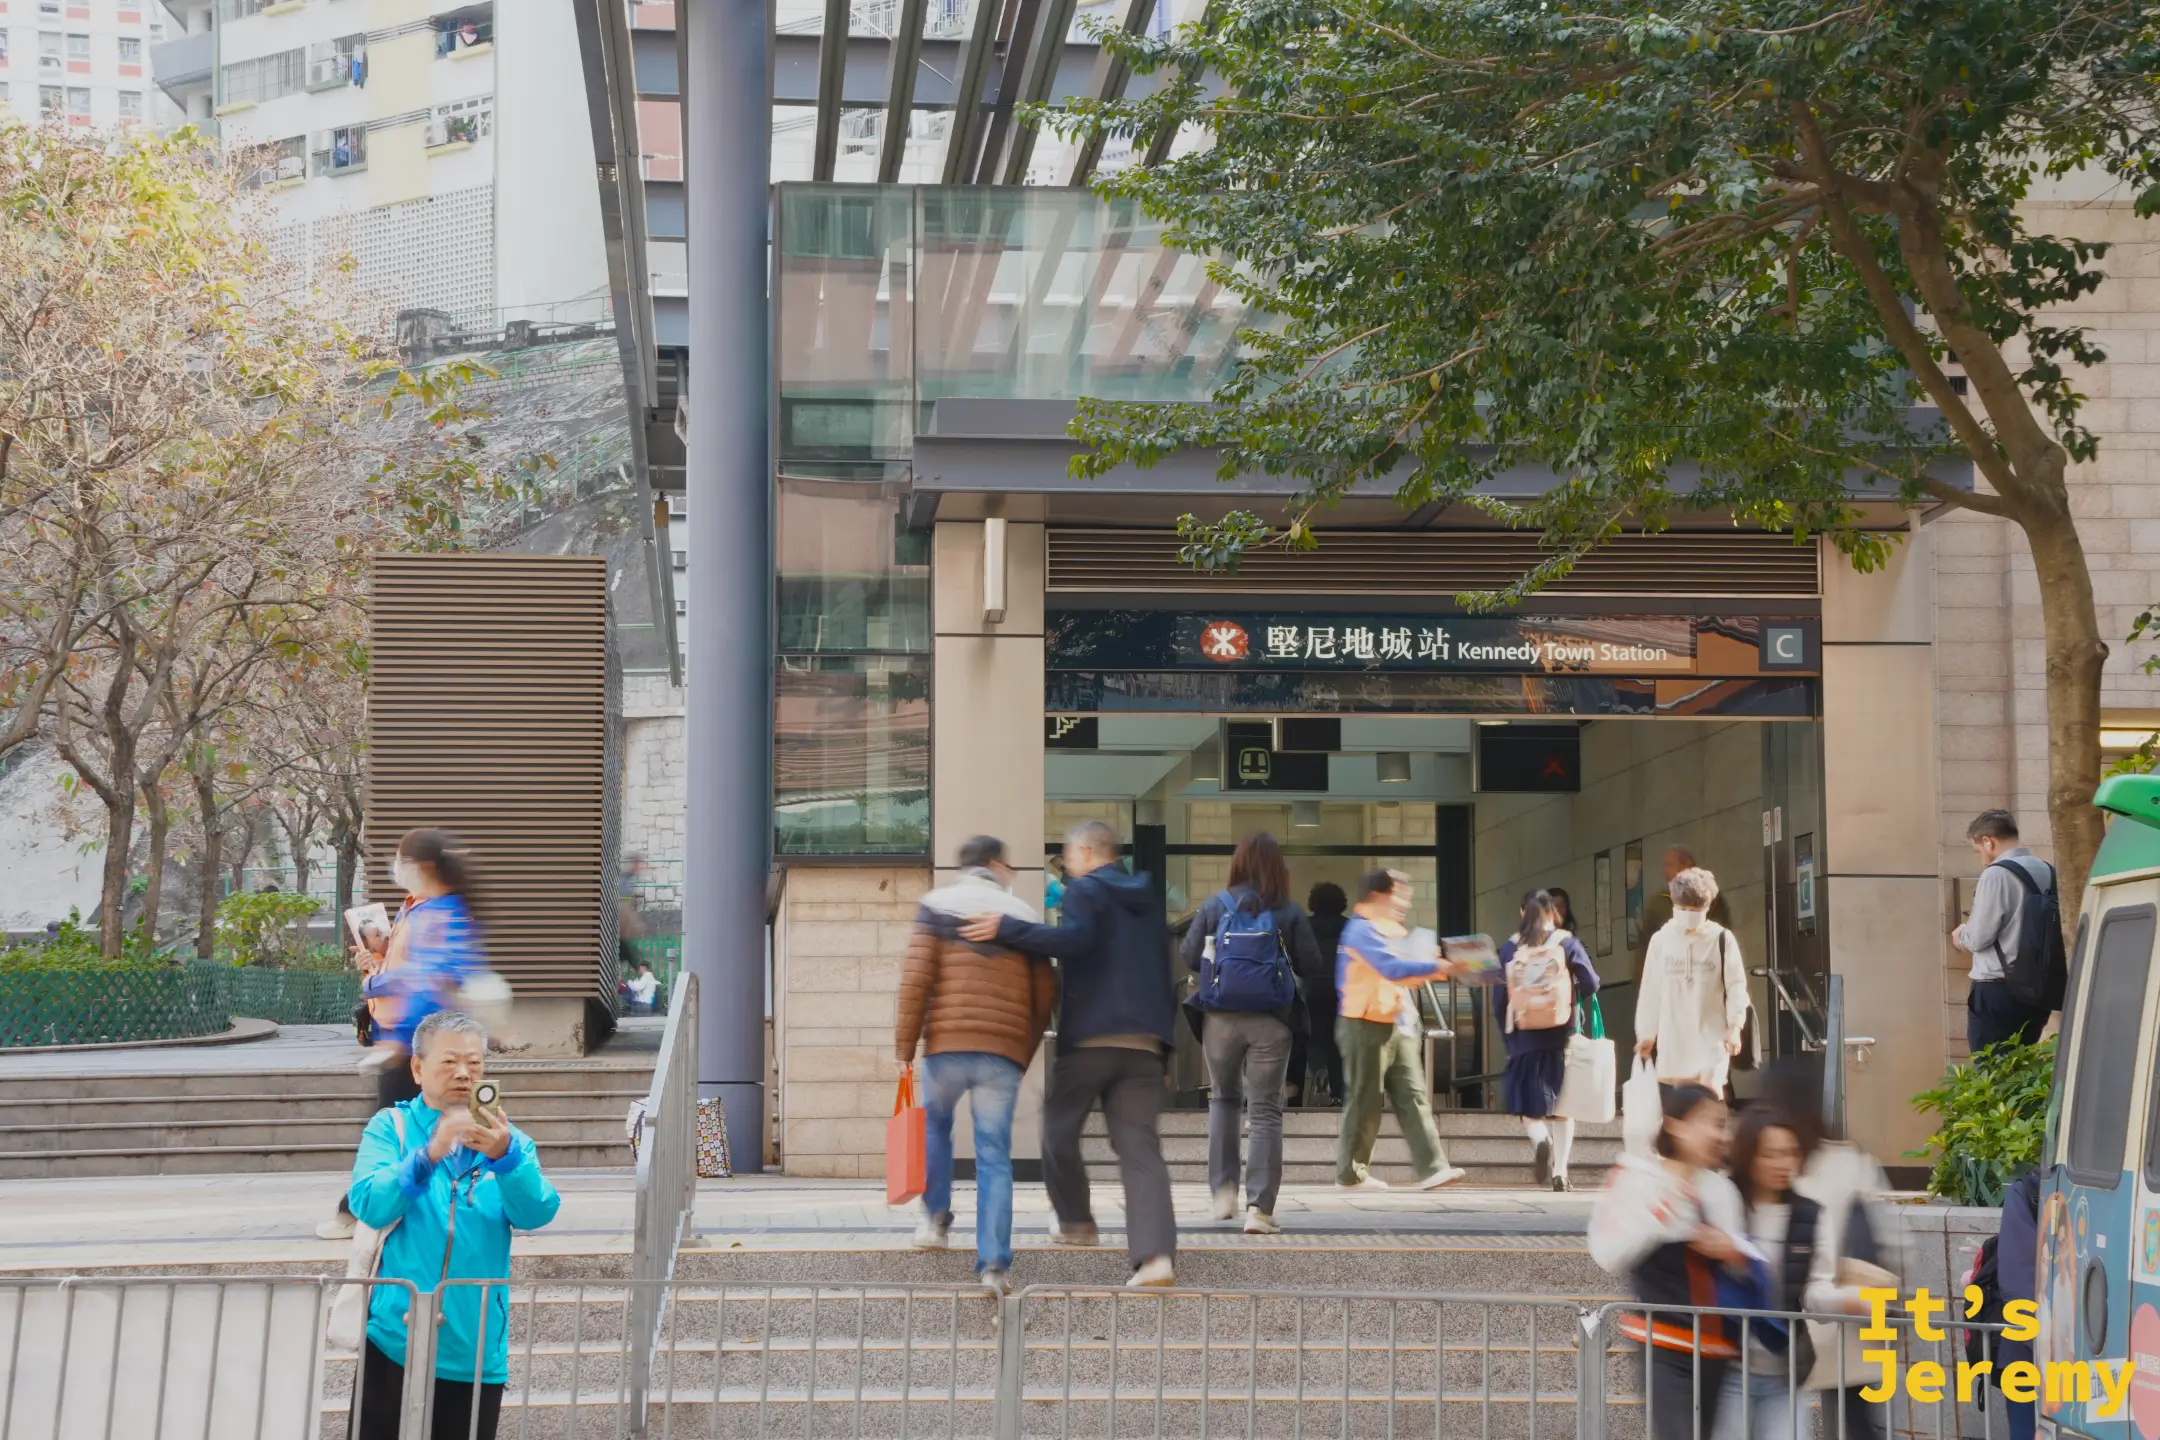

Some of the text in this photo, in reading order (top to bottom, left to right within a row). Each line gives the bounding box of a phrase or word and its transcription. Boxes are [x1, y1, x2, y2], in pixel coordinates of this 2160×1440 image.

[1266, 626, 1450, 660] 堅尼地城站
[1458, 642, 1667, 663] Kennedy Town Station
[1776, 634, 1794, 658] C
